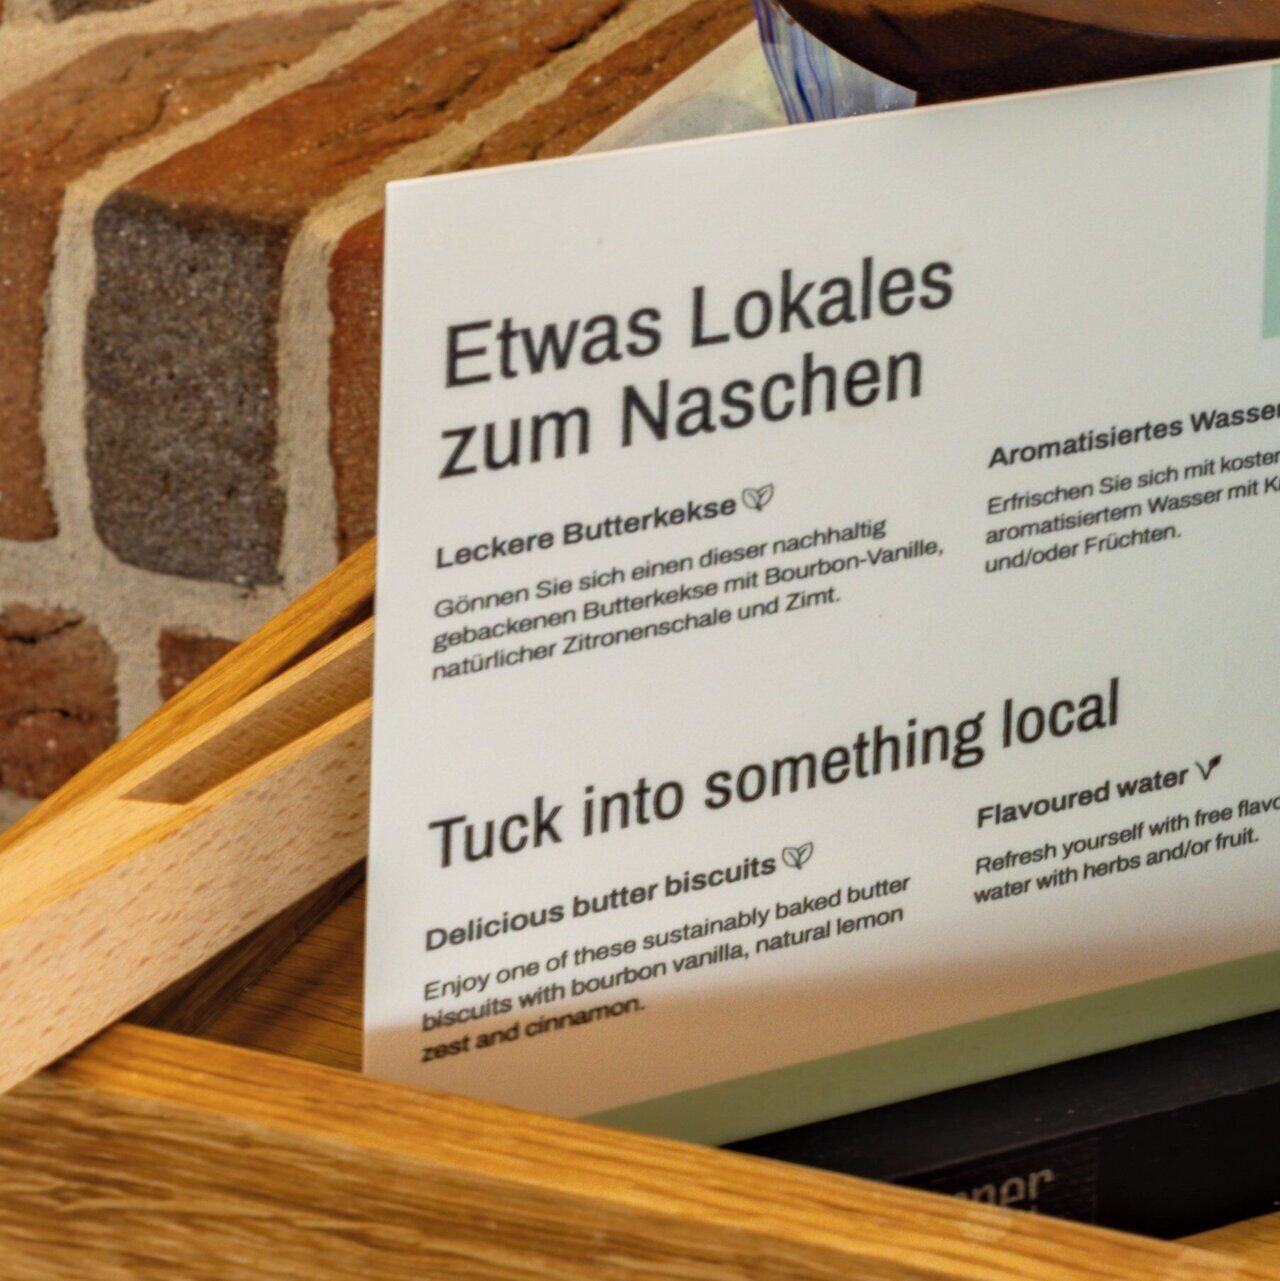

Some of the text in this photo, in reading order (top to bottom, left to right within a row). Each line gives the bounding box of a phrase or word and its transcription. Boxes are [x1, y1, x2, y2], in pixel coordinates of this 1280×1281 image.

[445, 255, 954, 389] Etwas Lokales
[438, 350, 923, 480] zum Naschen
[987, 419, 1184, 469] Aromatisiertes
[985, 503, 1143, 545] aromatisiertem
[1147, 488, 1224, 515] Wasser
[1227, 479, 1259, 501] mit
[987, 483, 1094, 516] Erfrischen
[1098, 474, 1133, 495] Sie
[1137, 465, 1179, 489] sich
[1183, 458, 1216, 480] mit
[433, 519, 887, 619] Gönnen Sie sich einen dieser nachhaltig
[435, 498, 737, 570] Leckere Butterkekse
[984, 525, 1182, 574] und/oder Früchten.
[432, 539, 944, 654] gebackenen Butterkekse mit Bourbon-Vanille,
[432, 586, 840, 681] natürlicher Zitronenschale und Zimt.
[427, 676, 1119, 869] Tuck into something local
[976, 767, 1190, 829] Flavoured water
[973, 826, 1260, 905] water with herbs and/or fruit.
[975, 842, 1058, 876] Refresh
[1061, 821, 1145, 861] yourself
[1148, 813, 1190, 837] with
[1193, 806, 1234, 828] free
[423, 876, 911, 1002] Enjoy one of these sustainably baked butter
[425, 856, 777, 952] Delicious butter biscuits
[421, 907, 904, 1033] biscuits with bourbon vanilla, natural lemon
[420, 997, 646, 1064] zest and cinnamon.
[954, 1168, 1055, 1206] ner
